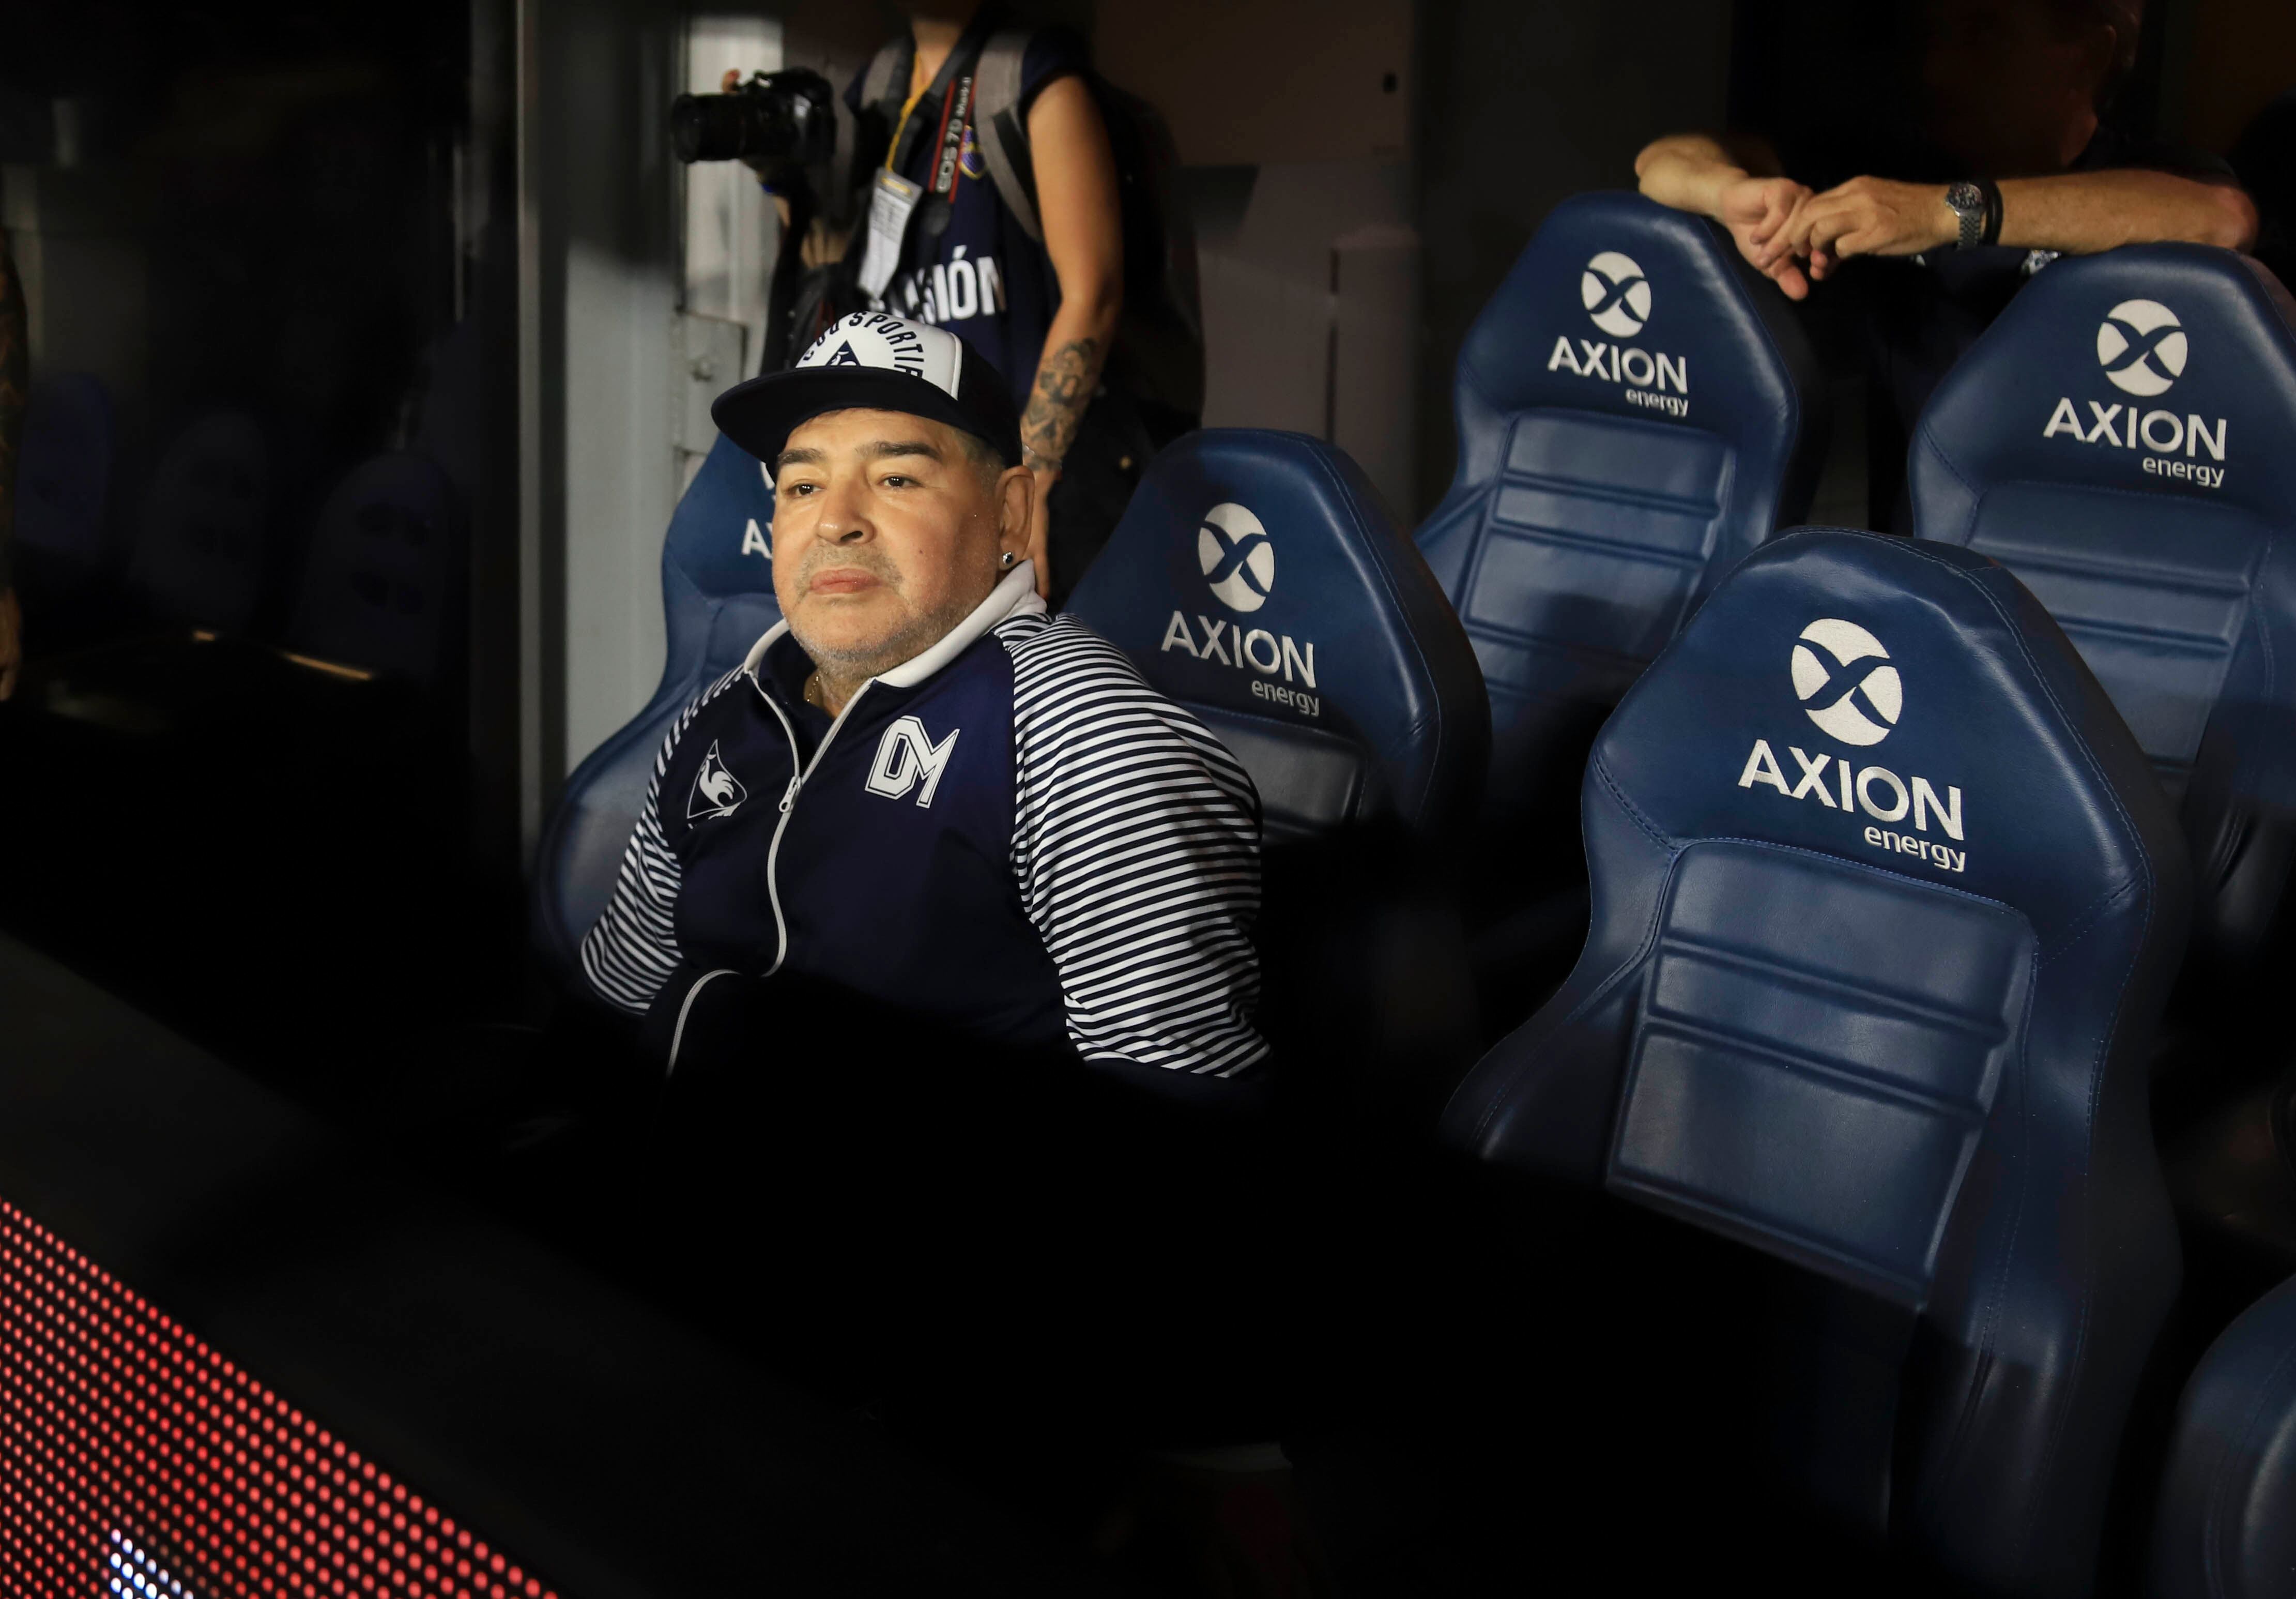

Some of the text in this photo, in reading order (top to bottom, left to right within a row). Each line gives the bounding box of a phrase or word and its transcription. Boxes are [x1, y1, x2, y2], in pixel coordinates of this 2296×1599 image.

[936, 146, 958, 193] EOS
[1547, 335, 1688, 395] AXION
[1625, 388, 1689, 418] energy
[2043, 397, 2227, 462] AXION
[2142, 456, 2225, 489] energy
[1161, 610, 1317, 689] AXION
[1251, 680, 1320, 718] energy
[1738, 739, 1964, 841] AXION
[1864, 826, 1966, 873] energy
